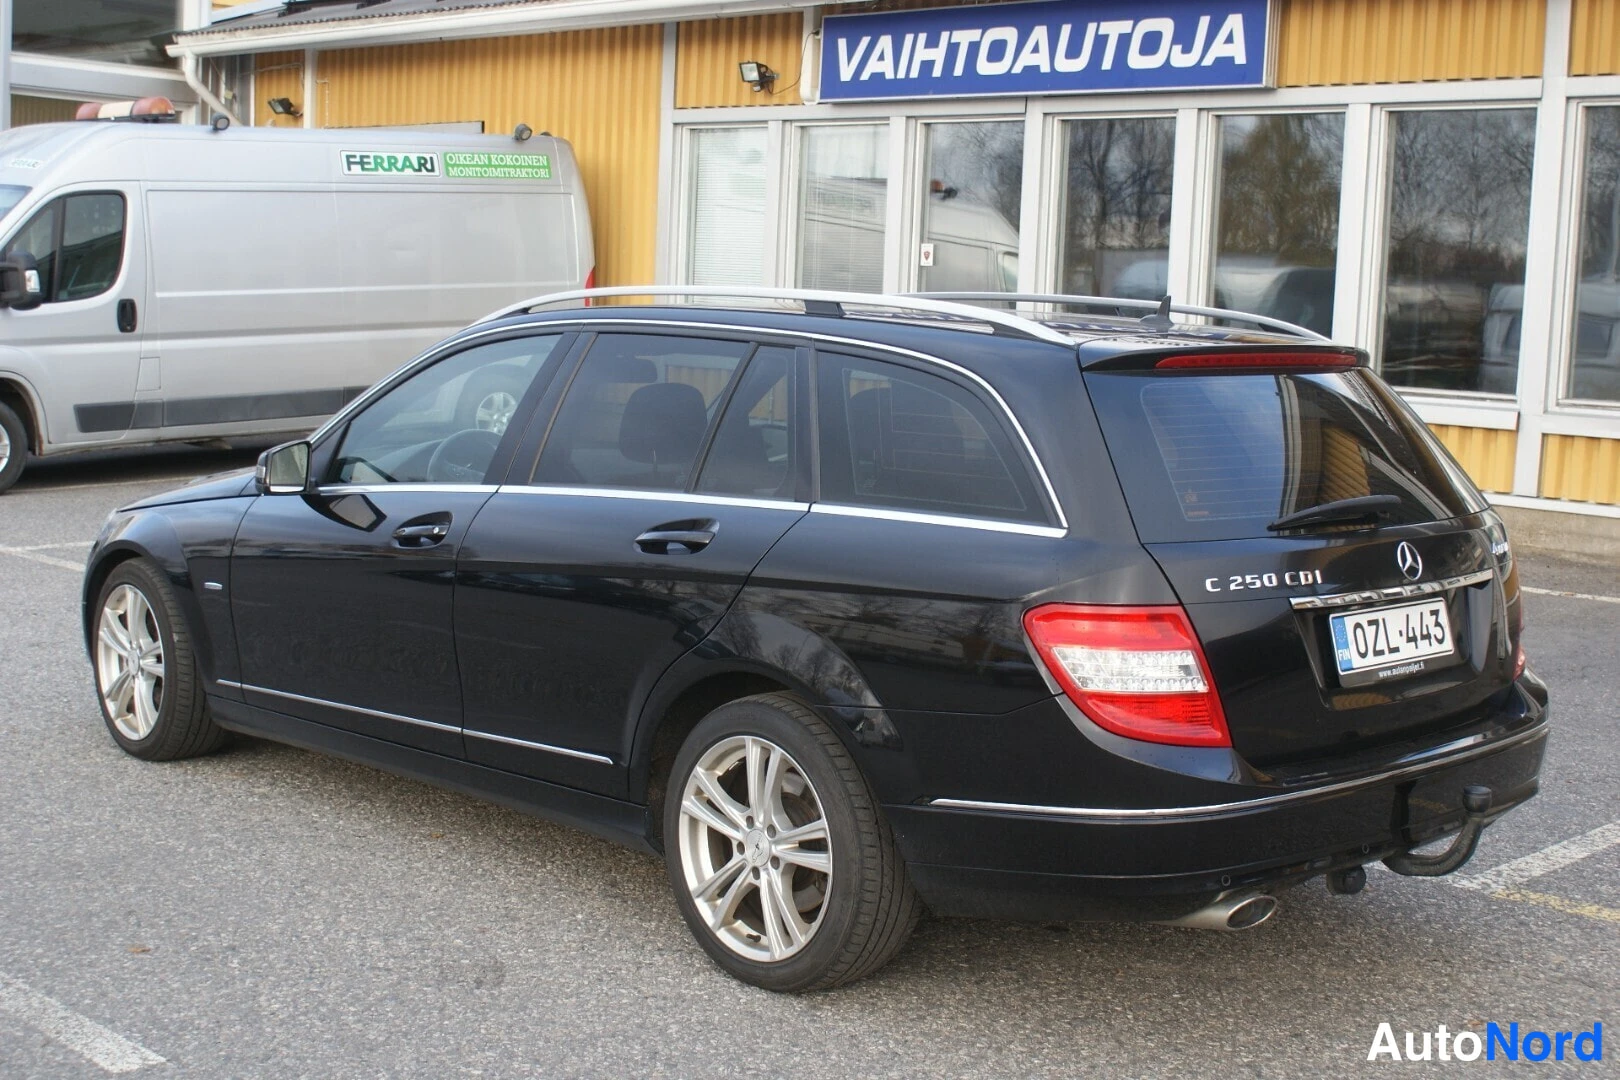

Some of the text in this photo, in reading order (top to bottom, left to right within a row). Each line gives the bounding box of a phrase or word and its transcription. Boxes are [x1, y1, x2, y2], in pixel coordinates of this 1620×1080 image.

[837, 13, 1247, 82] VAIHTOAUTOJA
[345, 154, 435, 173] FERRARI
[446, 153, 547, 166] OIKEAN KOKOINEN
[448, 166, 550, 178] MONITOIMITRAKTORI
[1205, 569, 1323, 592] C 250 CDI
[1353, 608, 1445, 659] OZL-443
[1337, 648, 1351, 661] FIN
